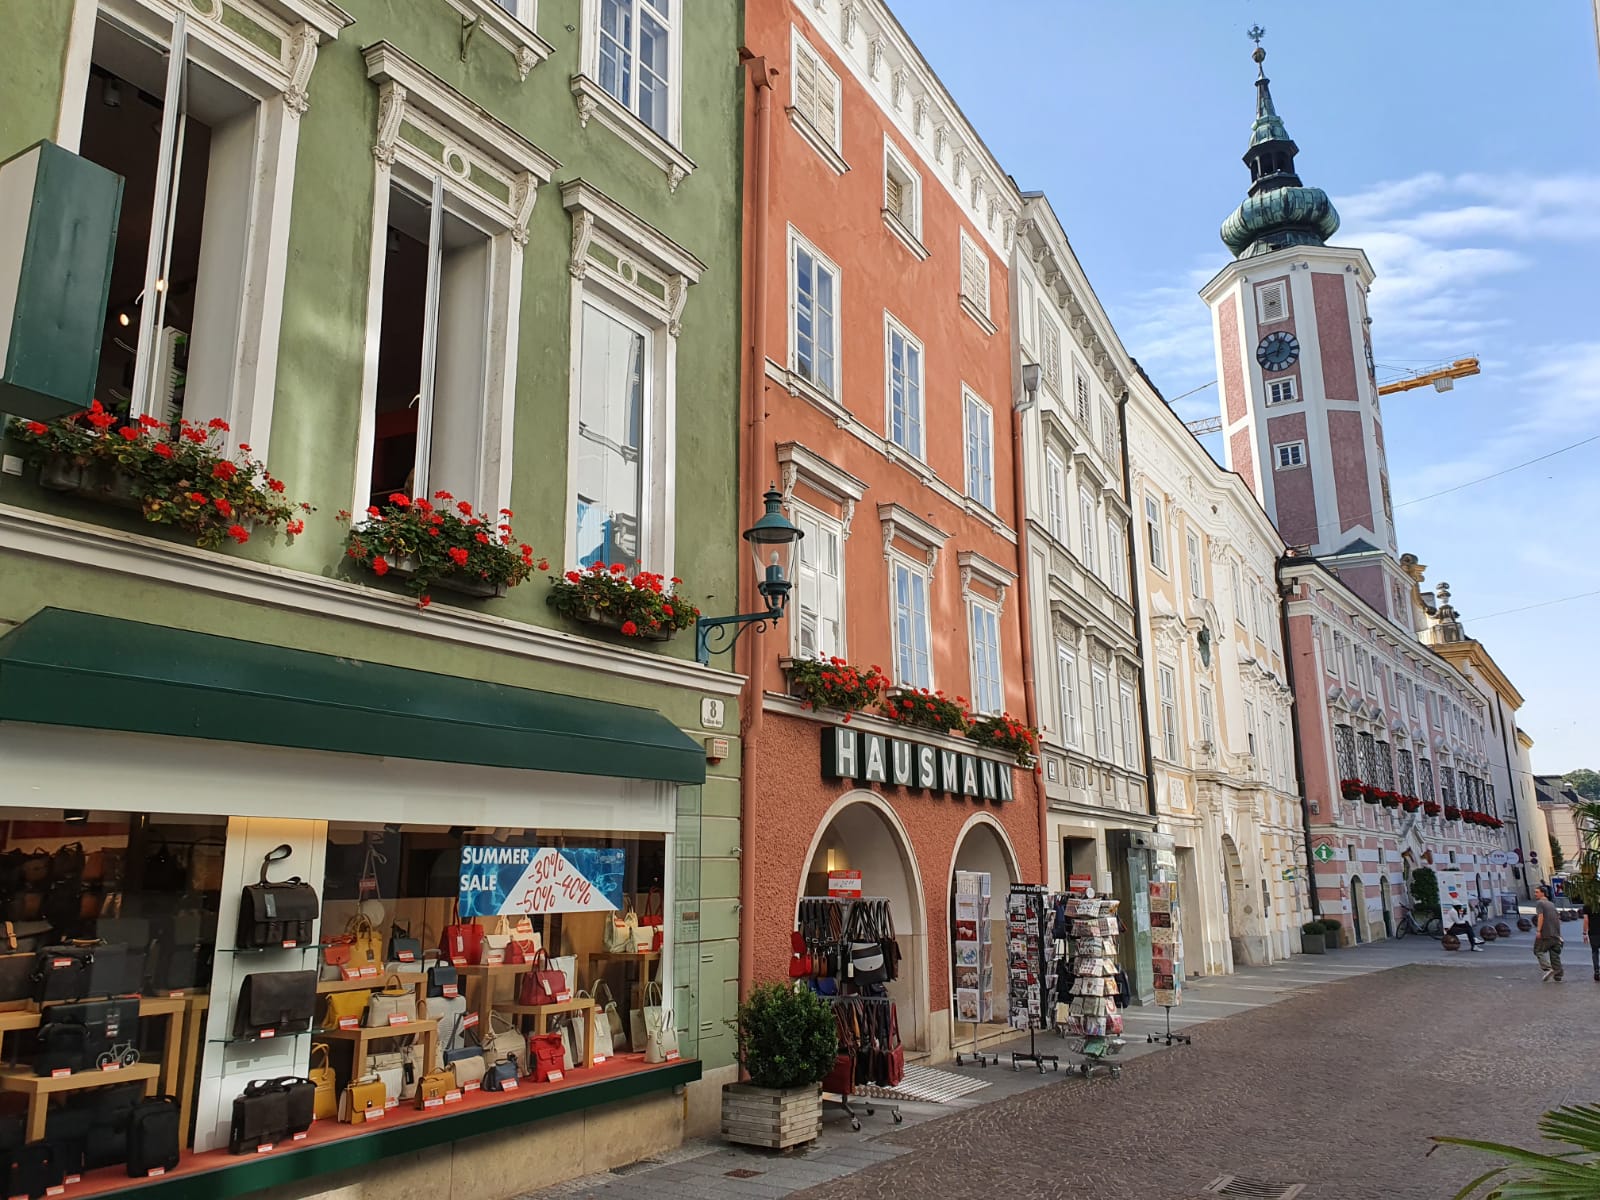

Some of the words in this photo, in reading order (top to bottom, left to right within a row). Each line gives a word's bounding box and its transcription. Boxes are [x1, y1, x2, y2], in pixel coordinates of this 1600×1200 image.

[710, 700, 717, 718] 8
[838, 729, 1013, 800] HAUSMANN
[462, 847, 529, 865] SUMMER
[528, 851, 564, 884] -30%
[460, 874, 497, 892] SALE
[554, 874, 592, 905] -40%
[515, 885, 556, 914] -50%
